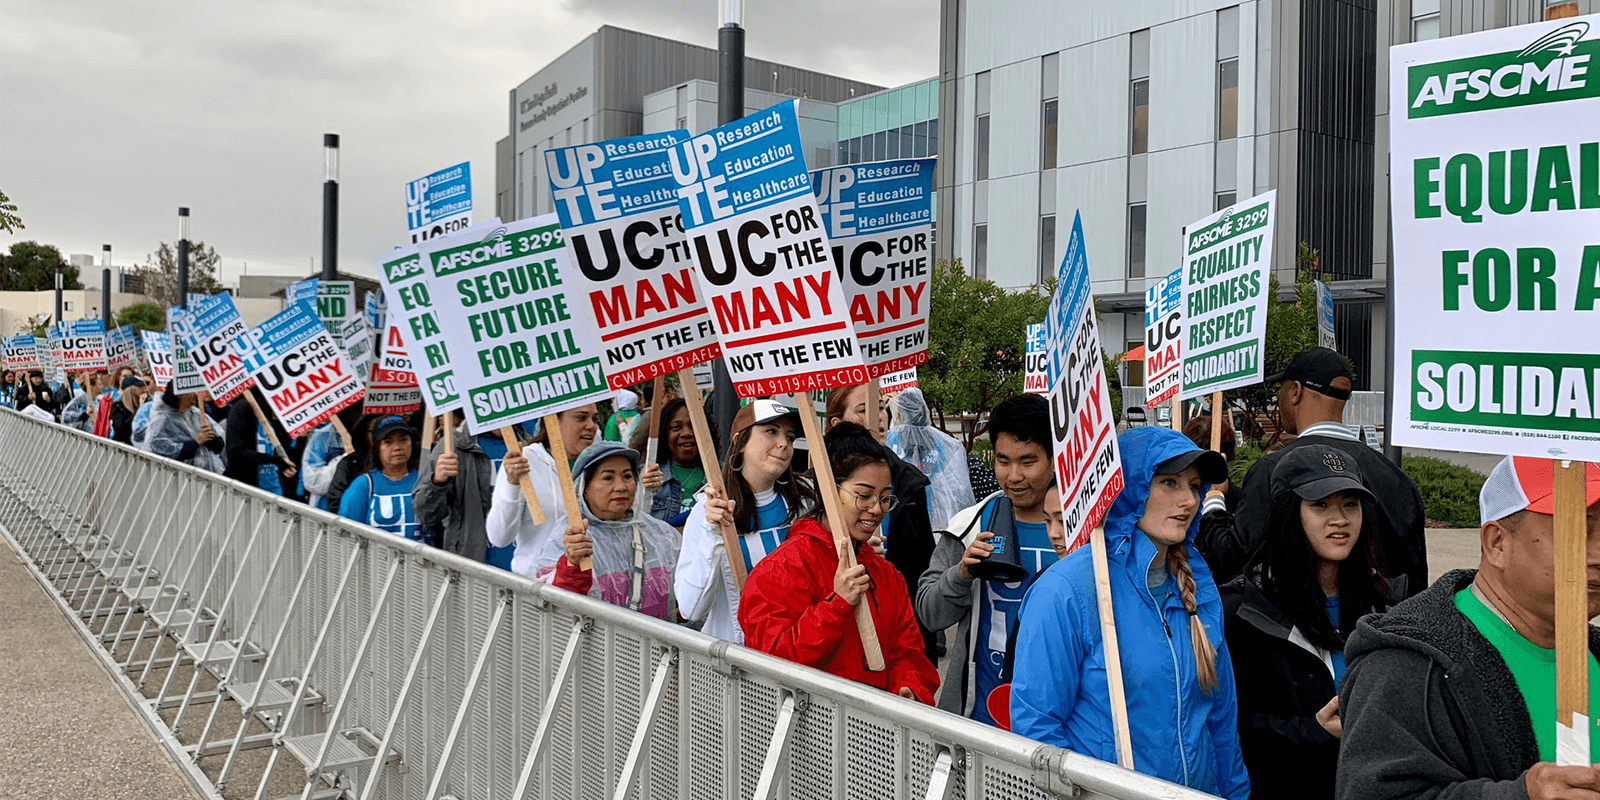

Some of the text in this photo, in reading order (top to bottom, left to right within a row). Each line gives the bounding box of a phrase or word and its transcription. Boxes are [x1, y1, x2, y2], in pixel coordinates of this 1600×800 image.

[1411, 54, 1591, 109] AFSCME
[716, 111, 781, 146] Research
[605, 134, 678, 156] Research
[667, 134, 718, 186] UP
[724, 143, 793, 176] Education
[430, 167, 462, 183] Research
[545, 144, 606, 189] UP
[612, 160, 672, 182] Educati
[857, 163, 920, 179] Research
[406, 178, 429, 206] UP
[430, 184, 466, 200] Education
[553, 180, 622, 225] TE
[620, 188, 679, 208] Healthc
[677, 174, 735, 226] TE
[732, 173, 808, 205] Healthcare
[857, 186, 923, 204] Education
[408, 200, 431, 229] TE
[431, 200, 471, 216] Healthcare
[859, 209, 930, 228] Healthcare
[445, 217, 469, 234] FOR
[1189, 208, 1268, 251] AFSCME 3299
[436, 229, 563, 272] AFSCME 3299
[570, 220, 665, 282] UC
[693, 220, 777, 286] UC
[770, 205, 819, 239] FOR
[777, 237, 828, 270] THE
[887, 232, 927, 258] FOR
[1189, 234, 1264, 286] EQUALITY
[389, 259, 421, 280] AFS
[456, 258, 563, 307] SECURE
[887, 257, 927, 281] THE
[1441, 246, 1557, 312] FOR
[589, 266, 697, 329] MAN
[711, 270, 832, 335] MANY
[849, 281, 927, 326] ANY
[1146, 277, 1168, 307] UP
[1187, 269, 1261, 319] FAIRNESS
[174, 313, 196, 337] UP
[261, 306, 302, 331] Research
[468, 293, 571, 342] FUTURE
[1146, 295, 1168, 325] TE
[231, 327, 264, 357] UP
[269, 315, 311, 341] Education
[275, 323, 325, 353] Healthcare
[895, 330, 925, 351] FEW
[1027, 324, 1040, 339] UP
[1148, 312, 1181, 352] UC
[1189, 305, 1256, 350] RESPECT
[6, 348, 24, 357] UC
[8, 355, 37, 363] MANY
[62, 338, 87, 350] UC
[63, 349, 103, 359] MANY
[106, 344, 124, 358] UC
[191, 336, 227, 367] UC
[221, 322, 244, 339] FOR
[241, 341, 281, 369] TE
[306, 346, 337, 367] THE
[477, 340, 532, 377] FOR
[535, 328, 581, 363] ALL
[606, 339, 646, 365] NOT
[652, 326, 693, 351] THE
[729, 352, 764, 373] NOT
[769, 344, 809, 367] THE
[812, 337, 853, 361] FEW
[1026, 338, 1040, 352] TE
[256, 353, 306, 391] UC
[300, 335, 329, 356] FOR
[883, 371, 915, 384] THE FEW
[1027, 354, 1047, 373] UC
[1052, 307, 1094, 443] UC FOR
[1080, 337, 1098, 391] THE
[1184, 344, 1258, 385] SOLIDARITY
[213, 372, 247, 397] NOT THE
[220, 377, 256, 404] SOLIDAR
[271, 358, 343, 411] MANY
[473, 362, 601, 417] SOLIDARITY
[612, 369, 646, 388] CWA
[737, 382, 766, 396] CWA
[1148, 379, 1166, 397] NOT
[1167, 370, 1179, 385] TH
[285, 380, 358, 427] NOT THE FEW
[368, 393, 390, 402] NOT
[393, 391, 409, 401] THE
[1057, 370, 1102, 496] MANY
[1066, 500, 1081, 538] NOT
[1081, 472, 1096, 510] THE
[1096, 439, 1115, 485] FEW
